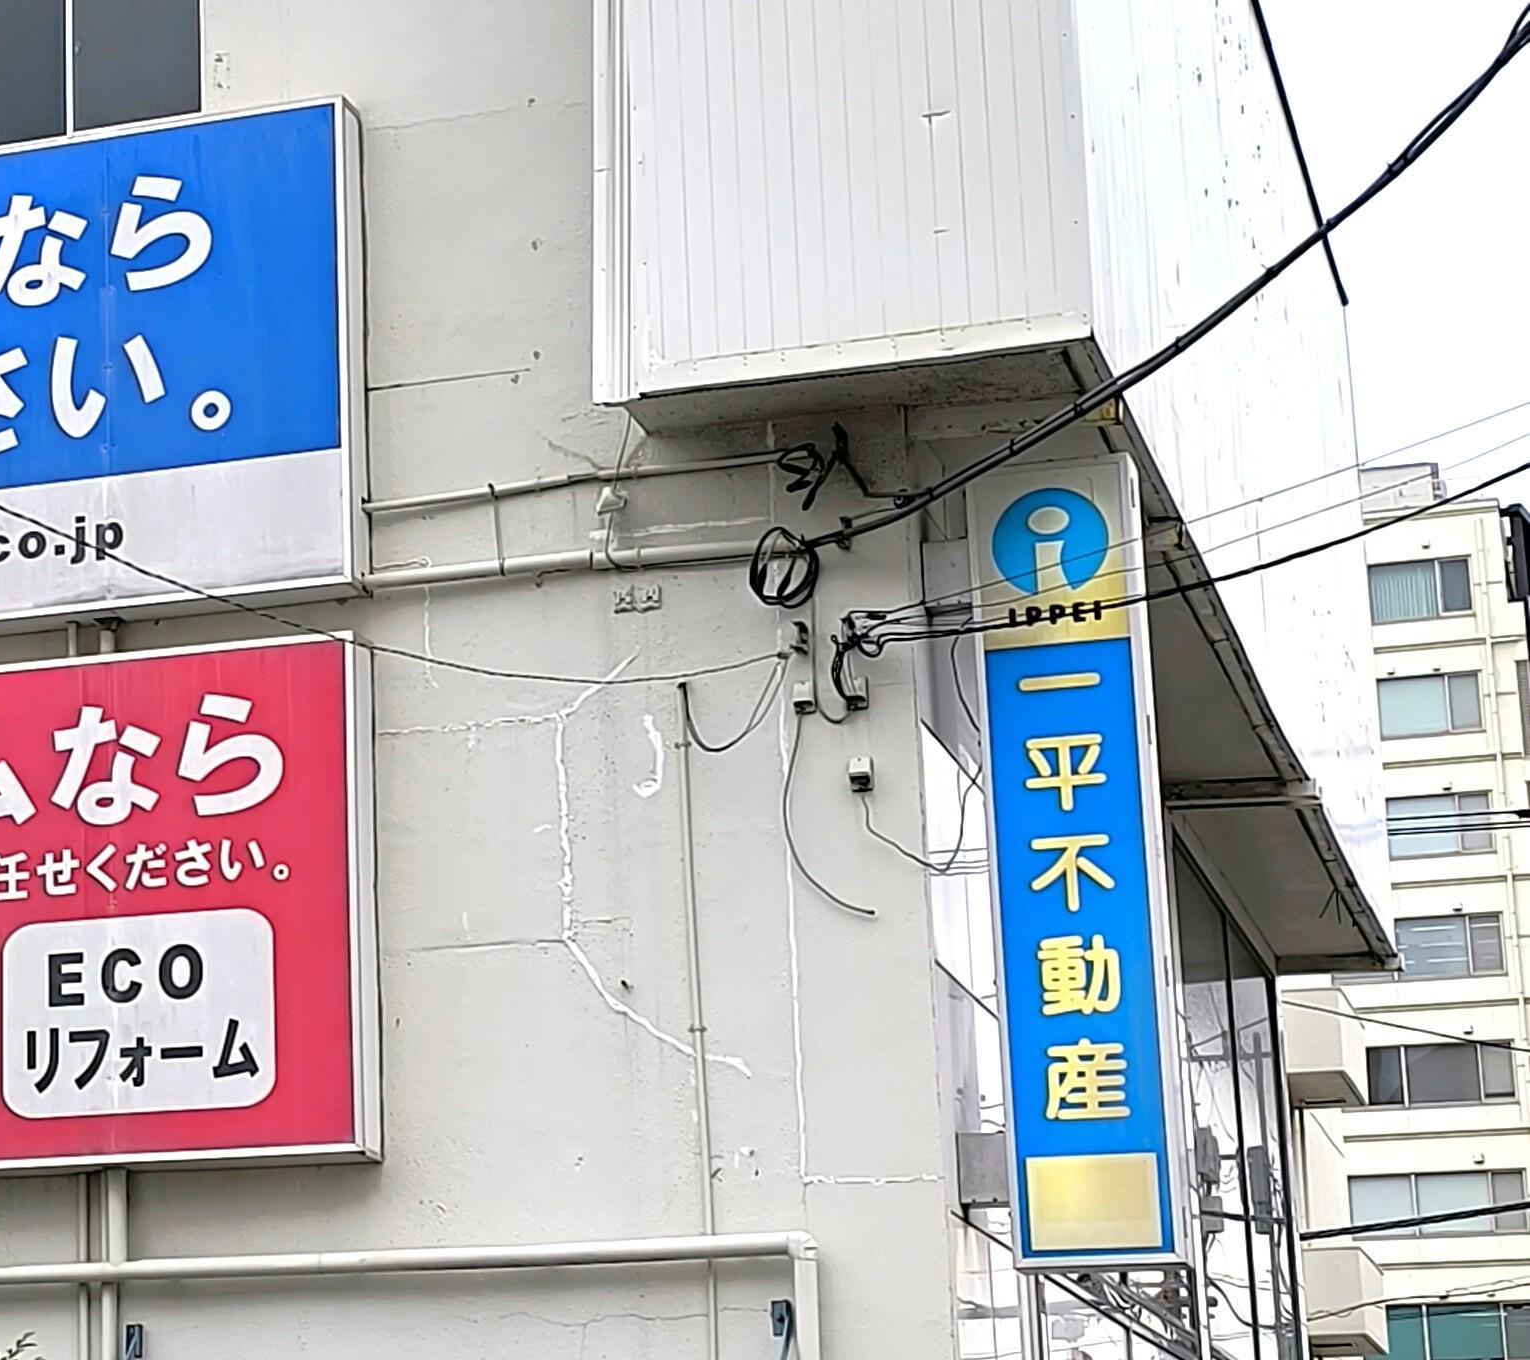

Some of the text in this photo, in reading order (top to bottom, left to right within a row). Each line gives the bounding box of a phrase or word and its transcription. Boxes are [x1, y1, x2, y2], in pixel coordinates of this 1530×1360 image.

[1008, 600, 1103, 627] IPPEI
[1017, 670, 1131, 1121] 一平不動産
[48, 943, 204, 1007] ECO
[25, 1017, 260, 1094] リフォーム
